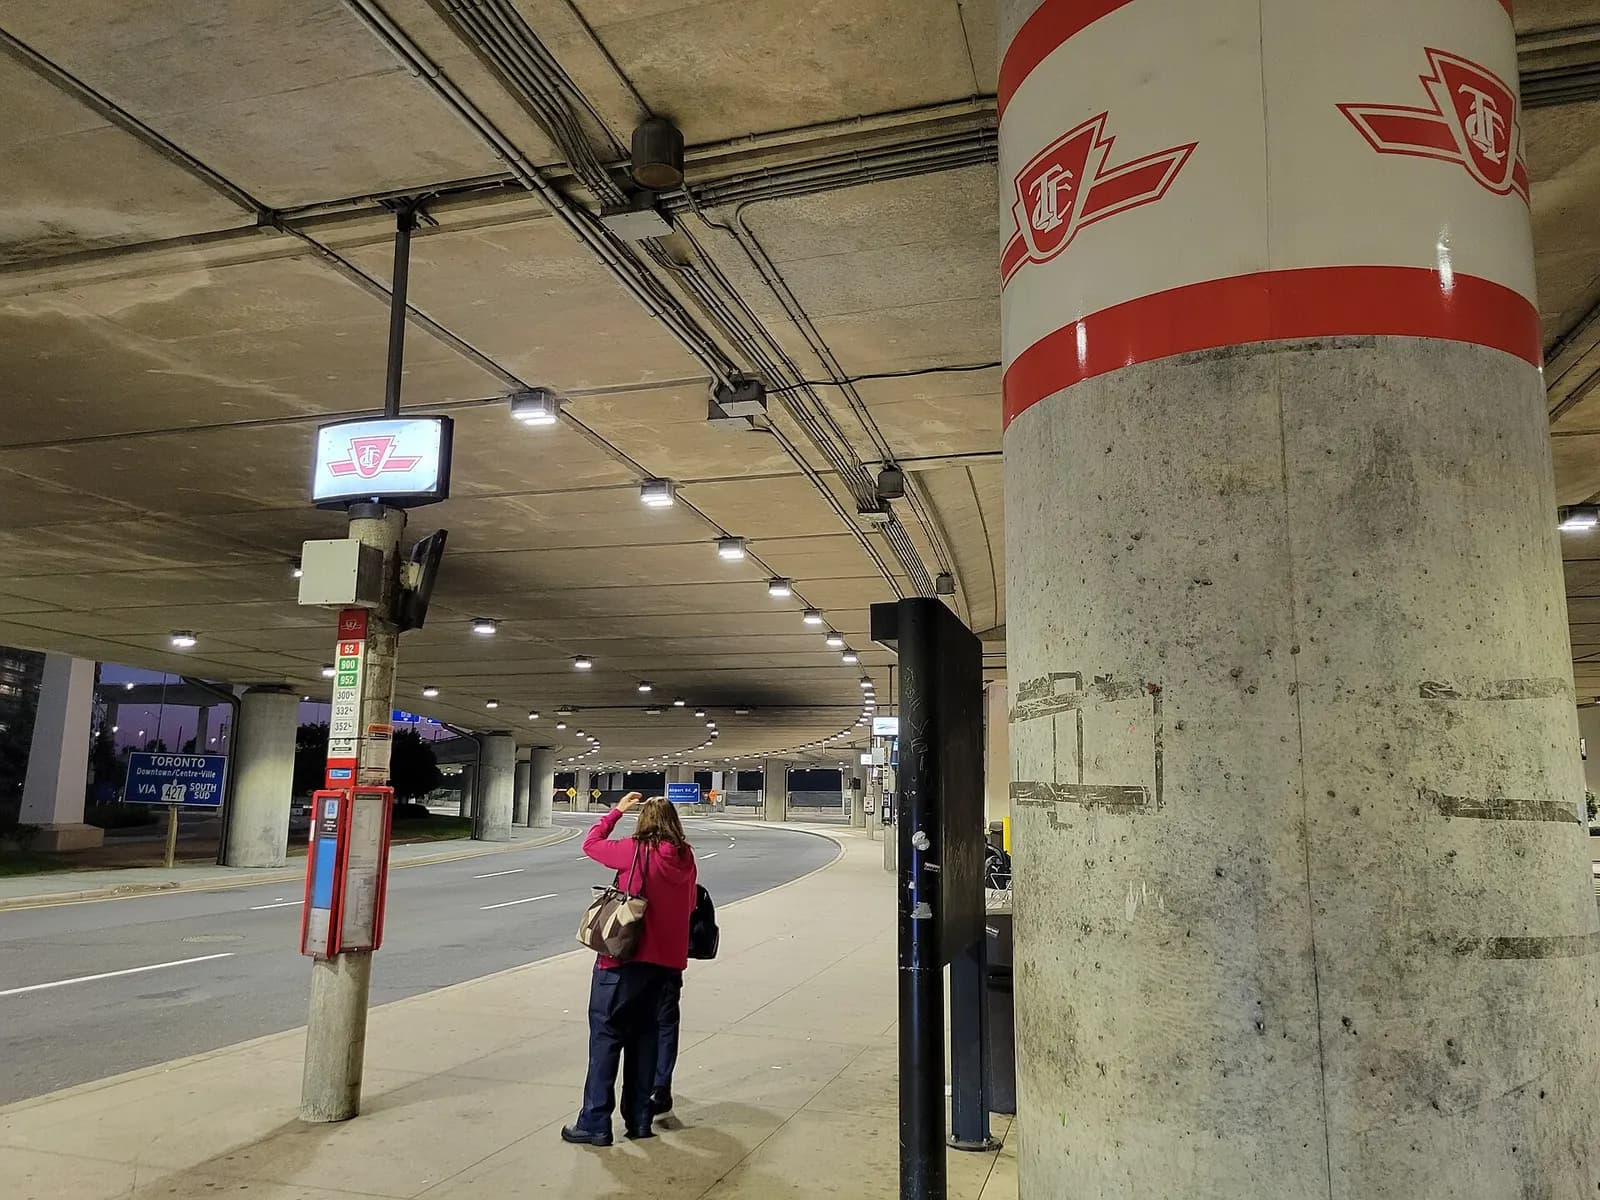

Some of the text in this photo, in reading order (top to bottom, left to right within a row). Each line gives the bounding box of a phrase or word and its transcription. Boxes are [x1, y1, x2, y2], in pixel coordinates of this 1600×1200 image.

[344, 644, 354, 654] 52
[340, 675, 354, 685] 952
[335, 706, 349, 716] 332
[334, 722, 348, 731] 352
[150, 755, 206, 768] TORONTO
[136, 767, 216, 778] Downtown/Centre-Ville
[138, 783, 183, 800] VIA 427
[190, 782, 217, 793] SOUTH
[193, 791, 211, 800] SUD
